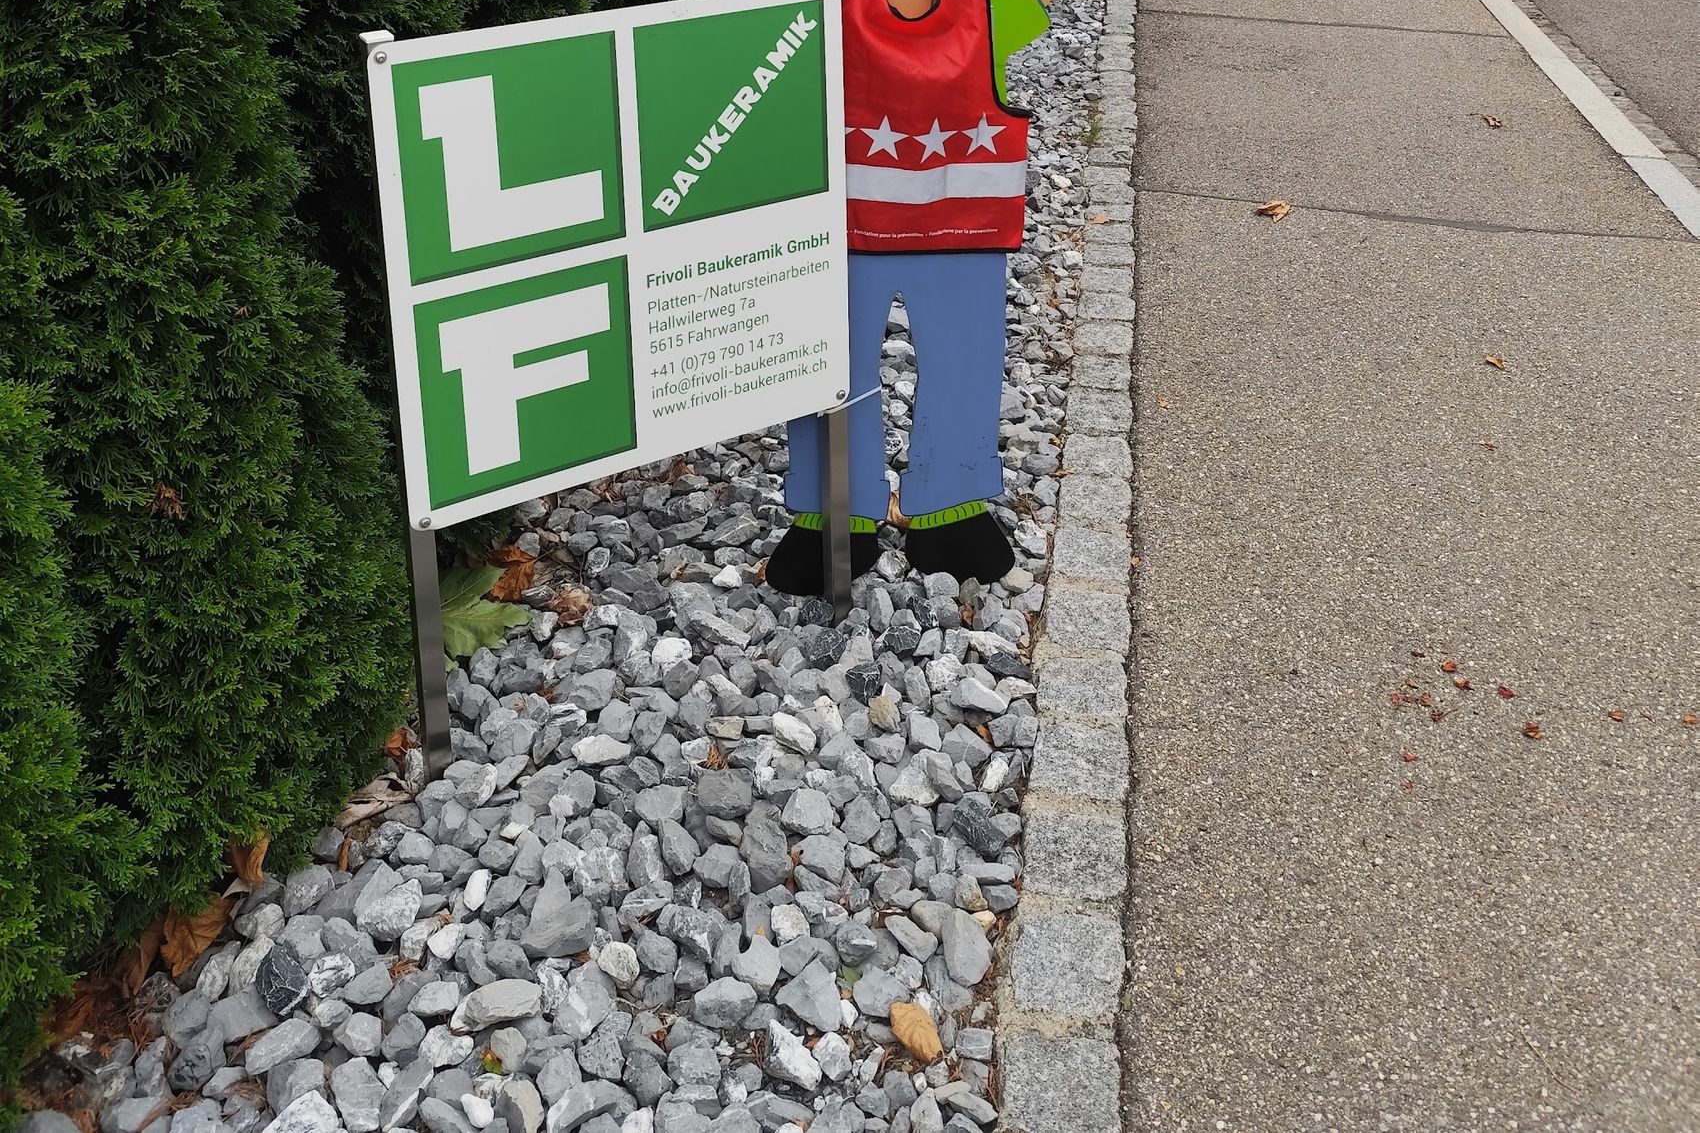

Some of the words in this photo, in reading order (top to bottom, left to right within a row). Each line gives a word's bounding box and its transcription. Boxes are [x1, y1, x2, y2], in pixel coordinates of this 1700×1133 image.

[651, 10, 818, 216] BAUKERAMIK
[418, 75, 604, 253] L
[646, 265, 692, 288] Frivoli
[697, 244, 783, 276] Baukeramik
[787, 232, 830, 254] GmbH
[647, 259, 830, 314] Platten-/Natursteinarbeiten
[649, 302, 736, 334] Hallwilerweg
[740, 297, 756, 311] 7a
[650, 333, 684, 354] 5615
[688, 313, 770, 344] Fahrwangen
[438, 282, 611, 476] F
[651, 362, 675, 378] +41
[681, 351, 716, 374] (0)79
[720, 343, 745, 360] 790
[750, 338, 764, 352] 14
[769, 332, 784, 347] 73
[651, 339, 828, 399] info@frivoli-baukeramik.ch
[652, 358, 827, 418] www.frivoli-baukeramik.ch
